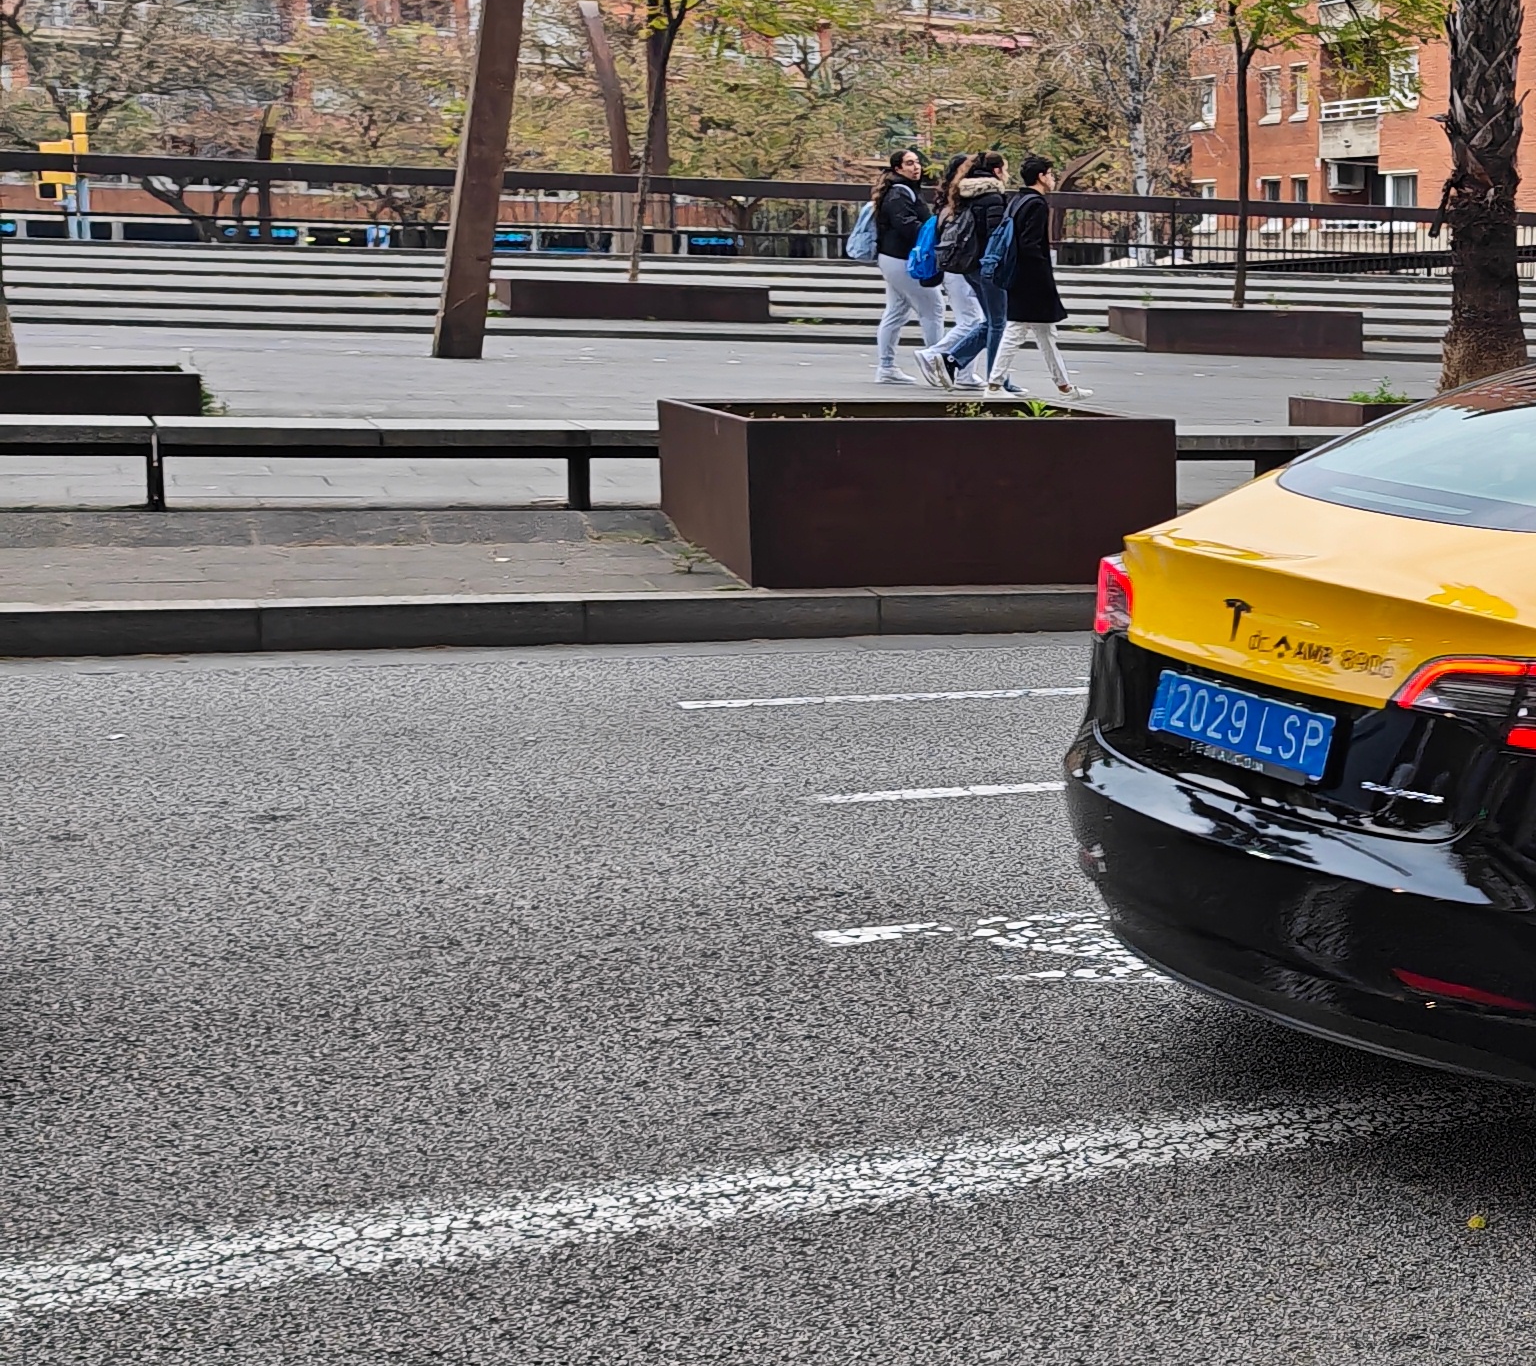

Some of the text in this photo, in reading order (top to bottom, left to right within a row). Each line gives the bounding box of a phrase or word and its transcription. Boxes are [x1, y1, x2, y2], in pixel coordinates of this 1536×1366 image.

[1340, 649, 1396, 679] 8906
[1169, 683, 1325, 765] 2029 LSP
